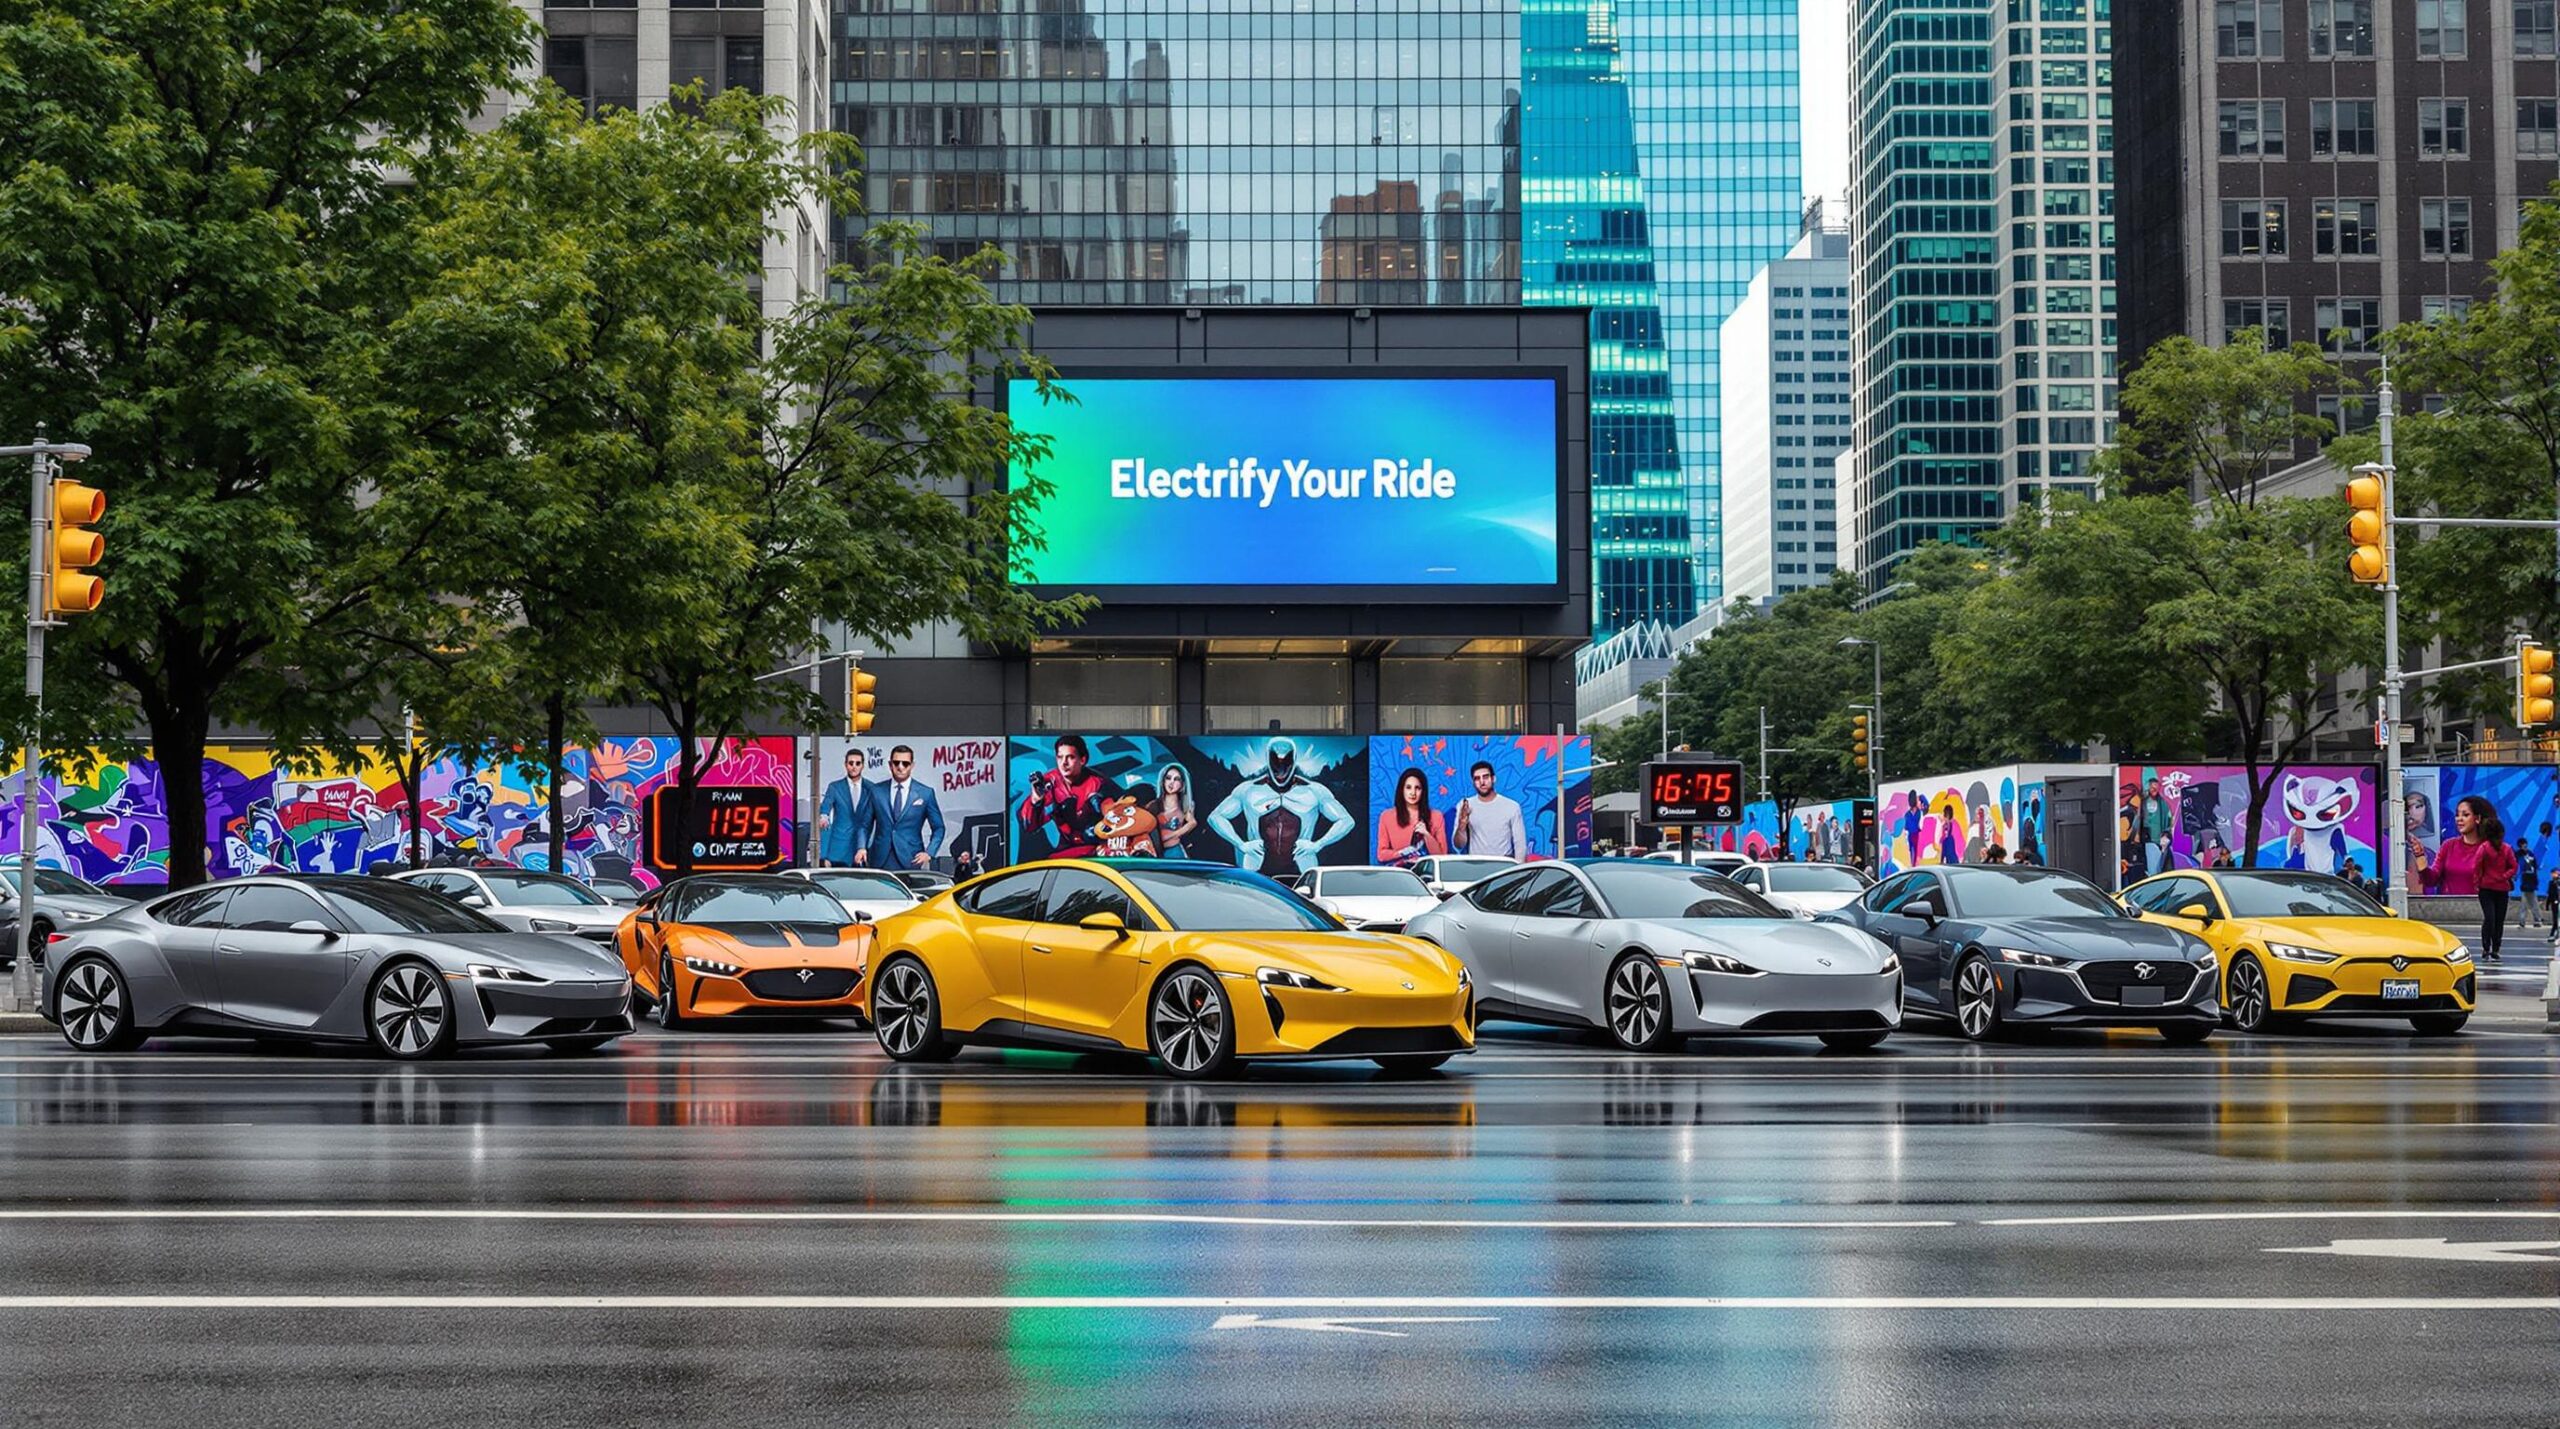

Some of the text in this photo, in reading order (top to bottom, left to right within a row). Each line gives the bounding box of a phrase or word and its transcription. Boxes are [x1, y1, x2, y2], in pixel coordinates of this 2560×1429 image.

[1110, 457, 1457, 508] Electrify Your Ride
[1655, 773, 1732, 802] 16:75
[709, 806, 770, 837] 1195
